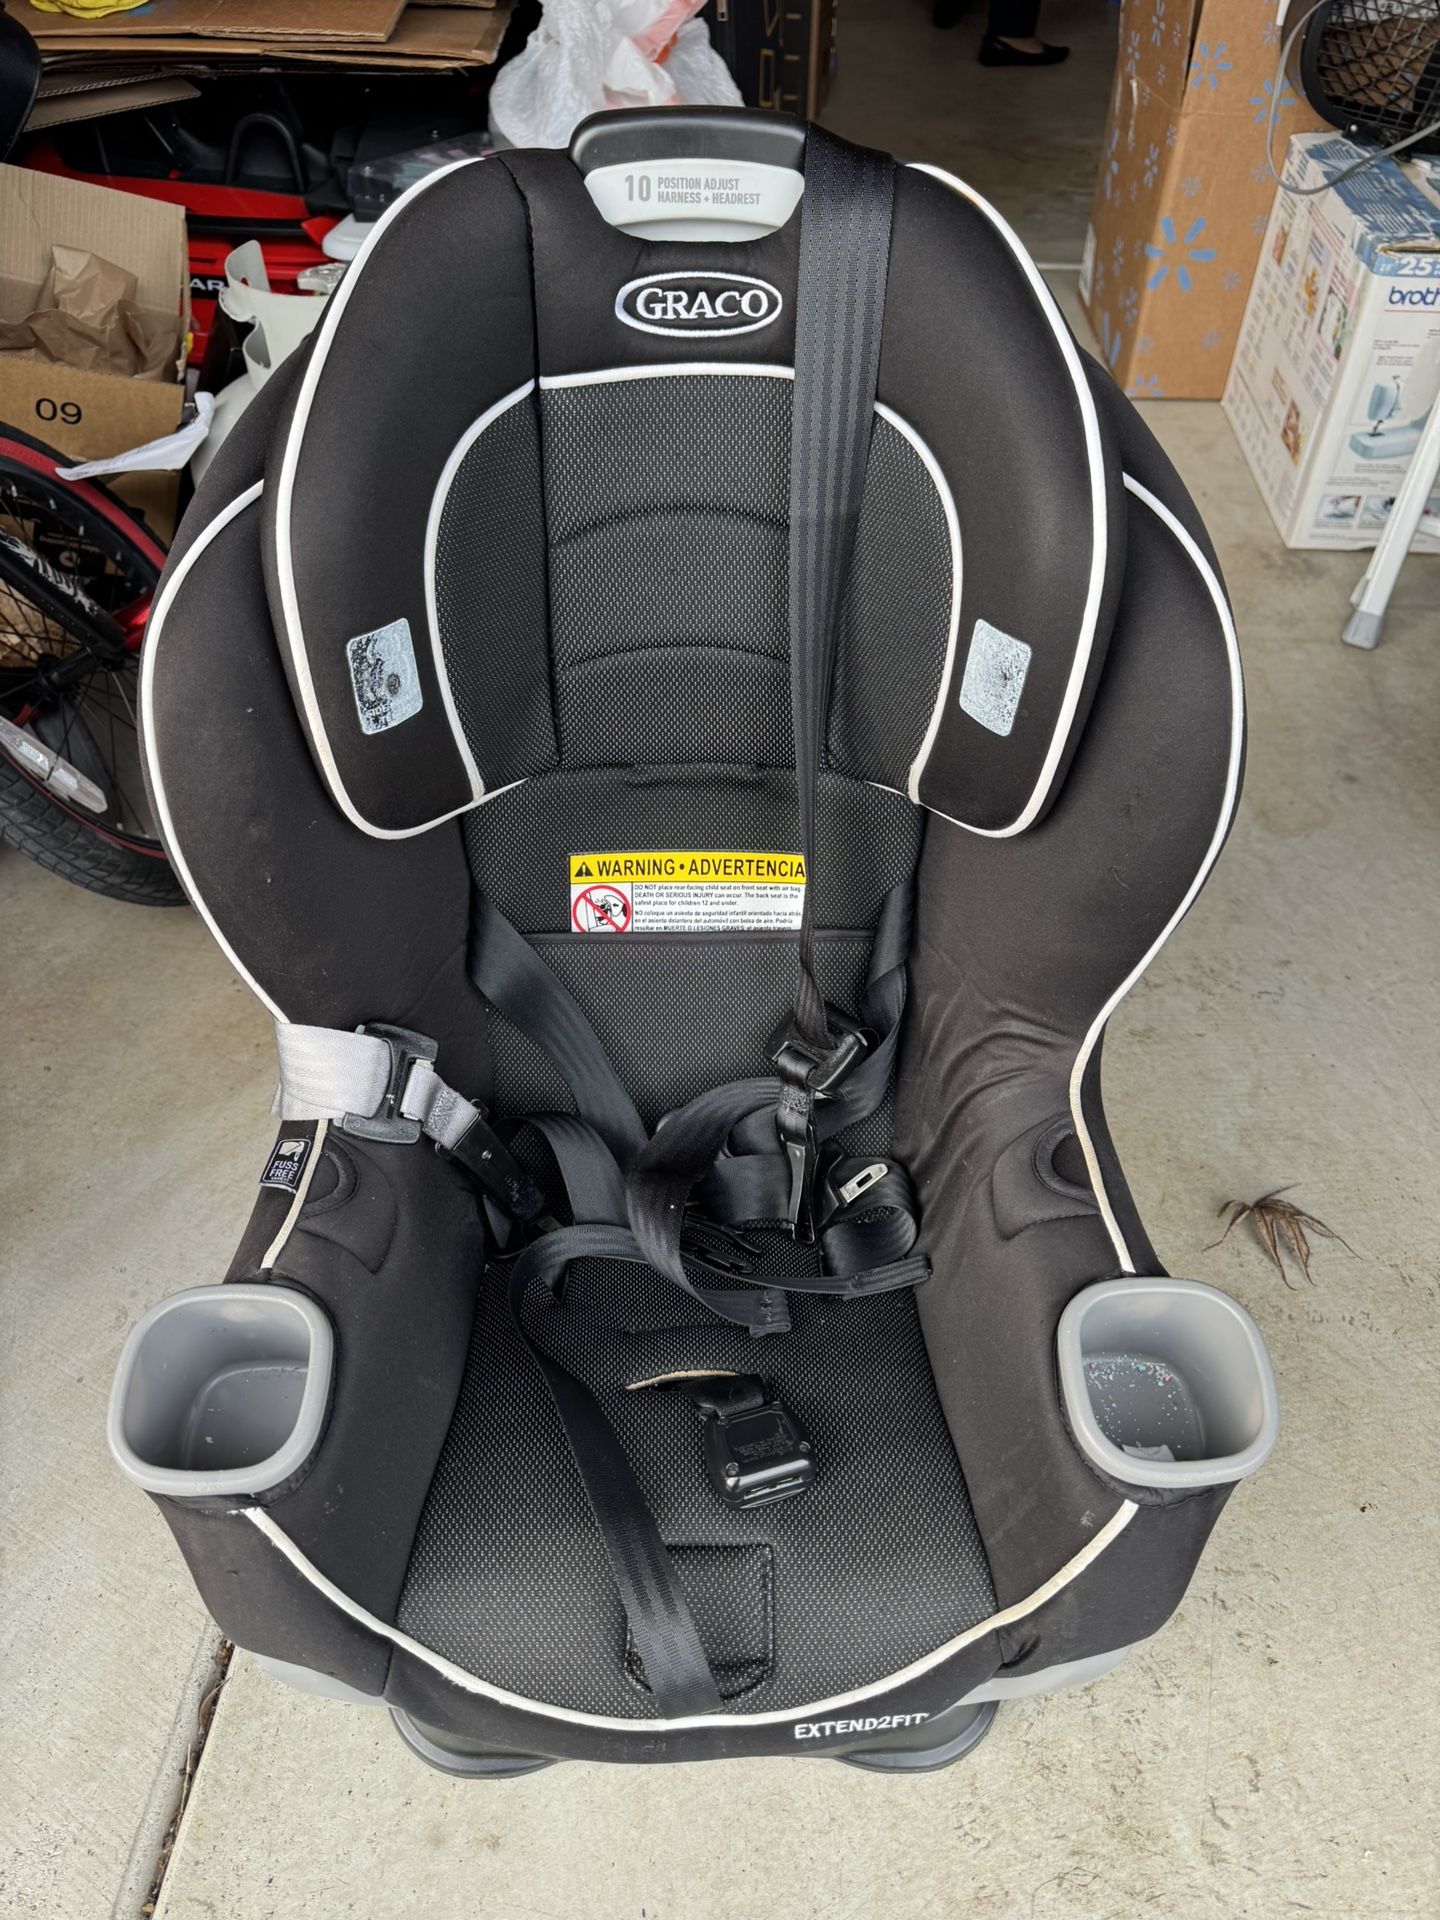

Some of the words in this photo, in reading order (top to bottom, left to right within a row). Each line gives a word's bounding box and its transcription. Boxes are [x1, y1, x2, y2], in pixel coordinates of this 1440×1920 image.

[625, 174, 651, 202] 10
[657, 177, 701, 190] POSITION
[704, 177, 740, 191] ADJUST
[657, 191, 701, 204] HARNESS
[712, 192, 761, 205] HEADREST
[635, 287, 768, 320] GRACO
[34, 397, 83, 425] 09
[597, 859, 675, 876] WARNING
[688, 858, 806, 878] ADVERTENCIA
[269, 1168, 296, 1180] FREE
[272, 1160, 299, 1171] FUSS
